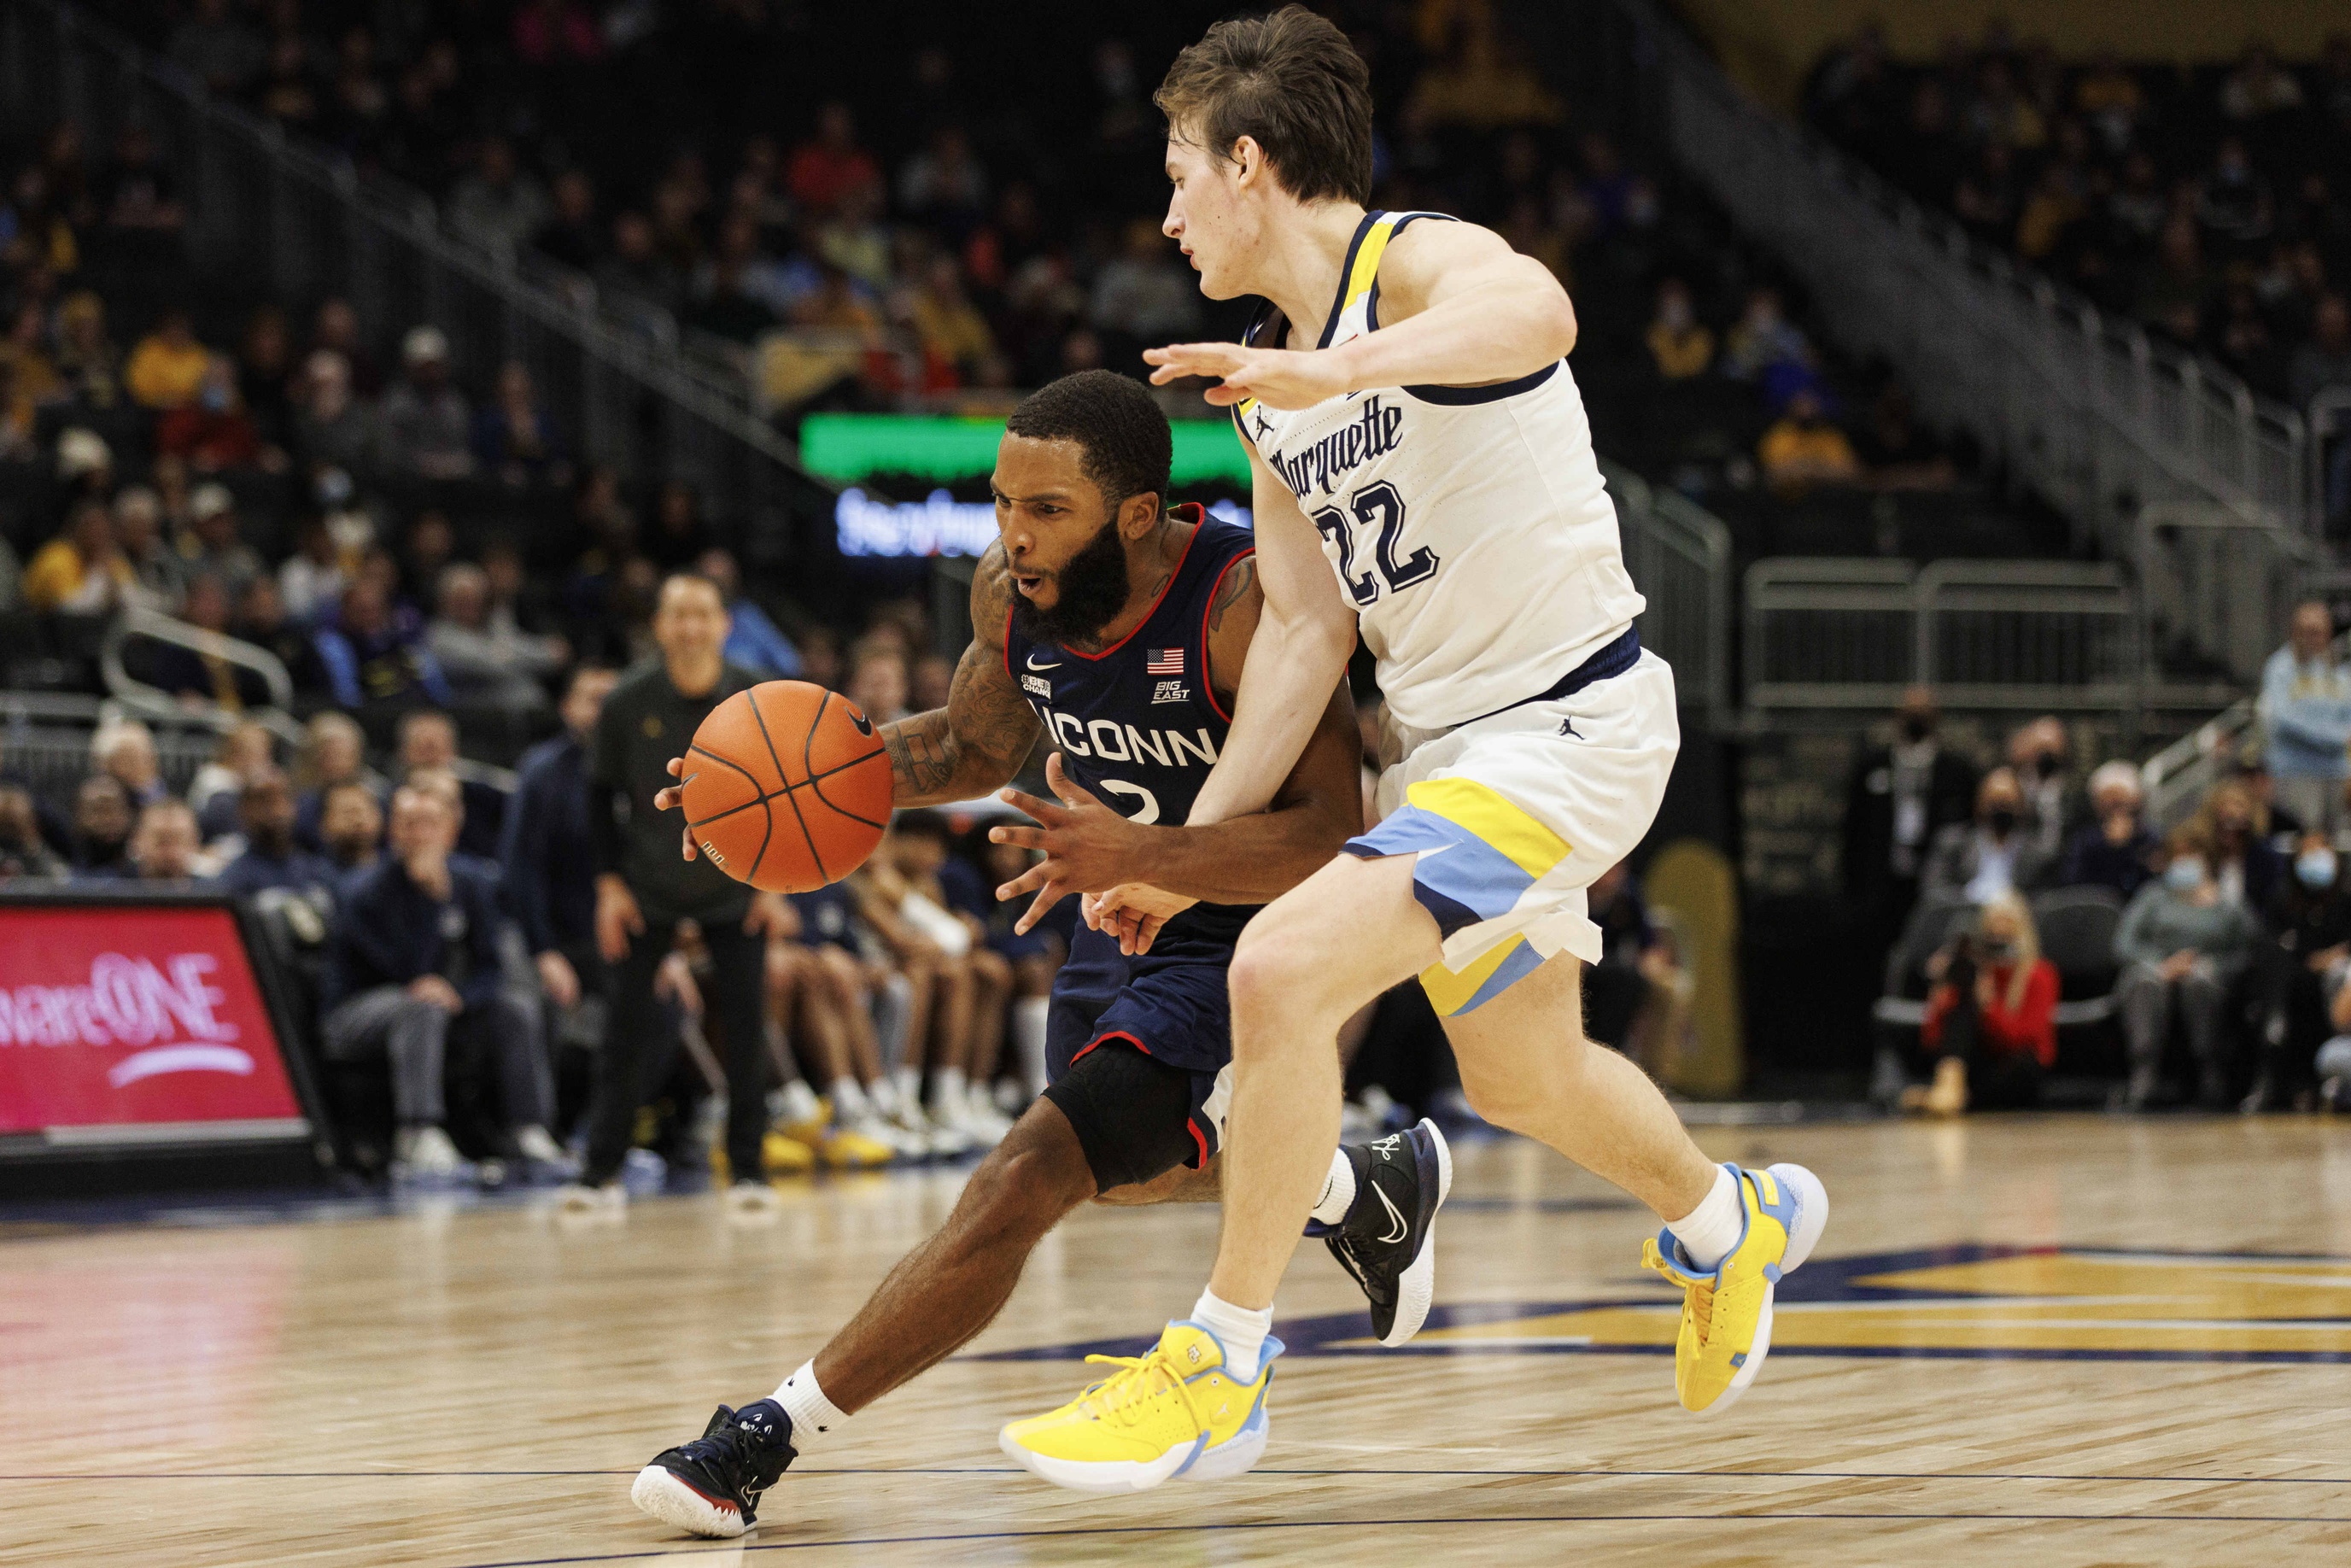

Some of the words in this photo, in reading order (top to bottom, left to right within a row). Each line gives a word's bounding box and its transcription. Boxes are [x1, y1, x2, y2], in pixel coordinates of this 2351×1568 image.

[1269, 394, 1404, 501] Marquette
[1311, 479, 1440, 606] 22
[1153, 689, 1190, 700] EAST
[1155, 681, 1181, 691] BIG
